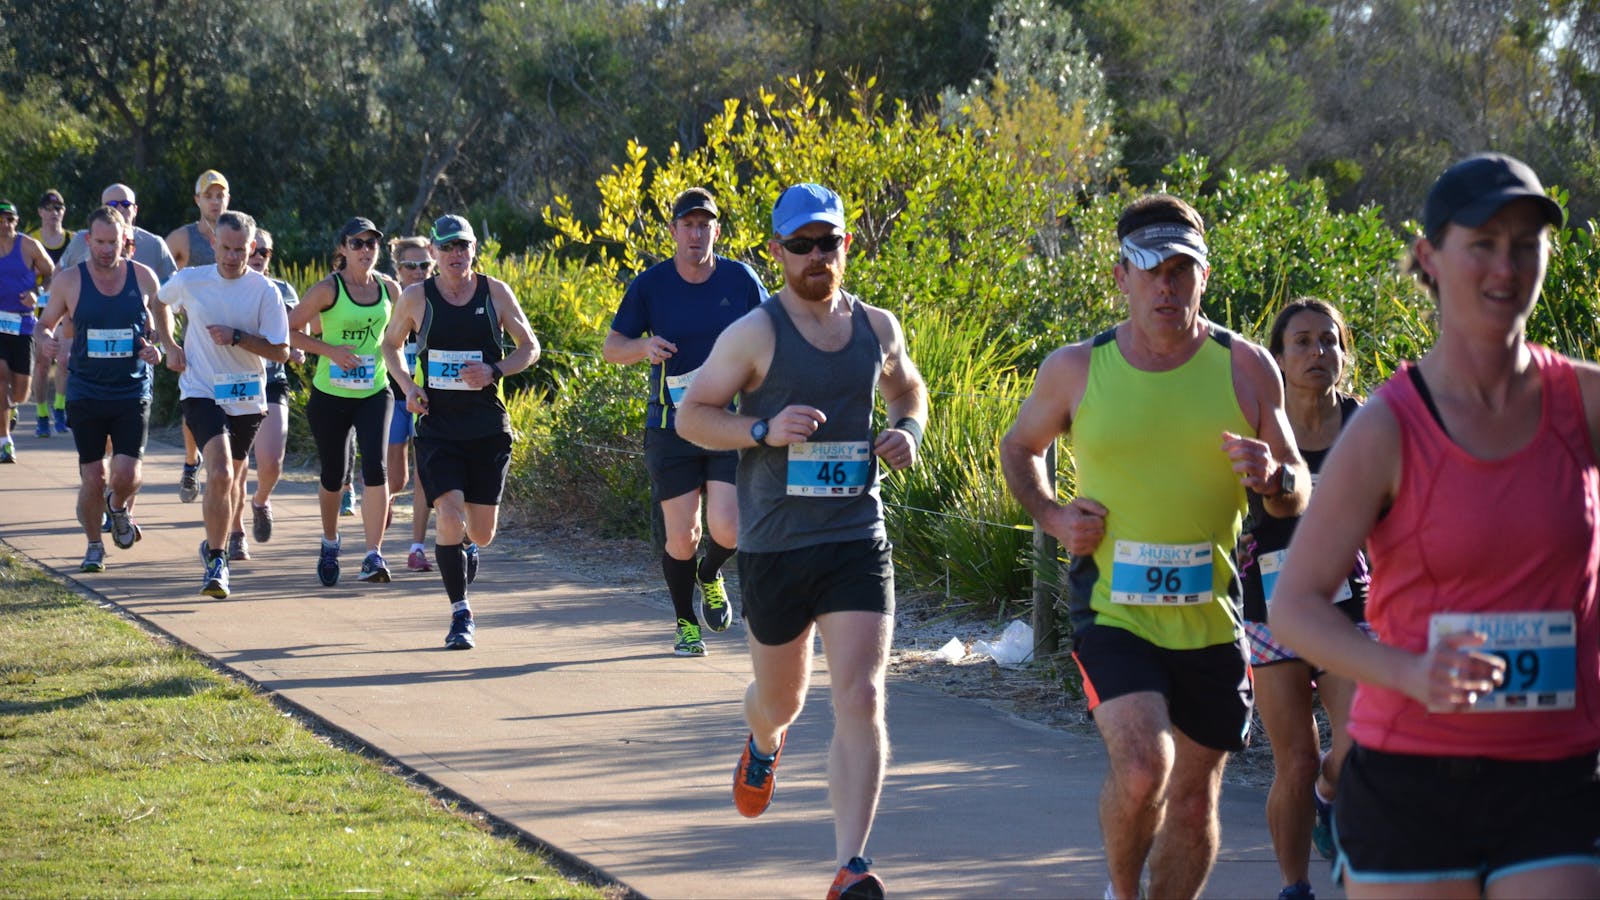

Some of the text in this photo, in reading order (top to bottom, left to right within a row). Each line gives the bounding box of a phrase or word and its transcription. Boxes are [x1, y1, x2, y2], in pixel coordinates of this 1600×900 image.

[342, 330, 366, 340] FIT
[104, 340, 117, 353] 17
[230, 383, 247, 397] 42
[819, 445, 855, 456] HUSKY
[817, 461, 847, 486] 46
[1146, 547, 1193, 561] HUSKY
[1146, 566, 1182, 593] 96
